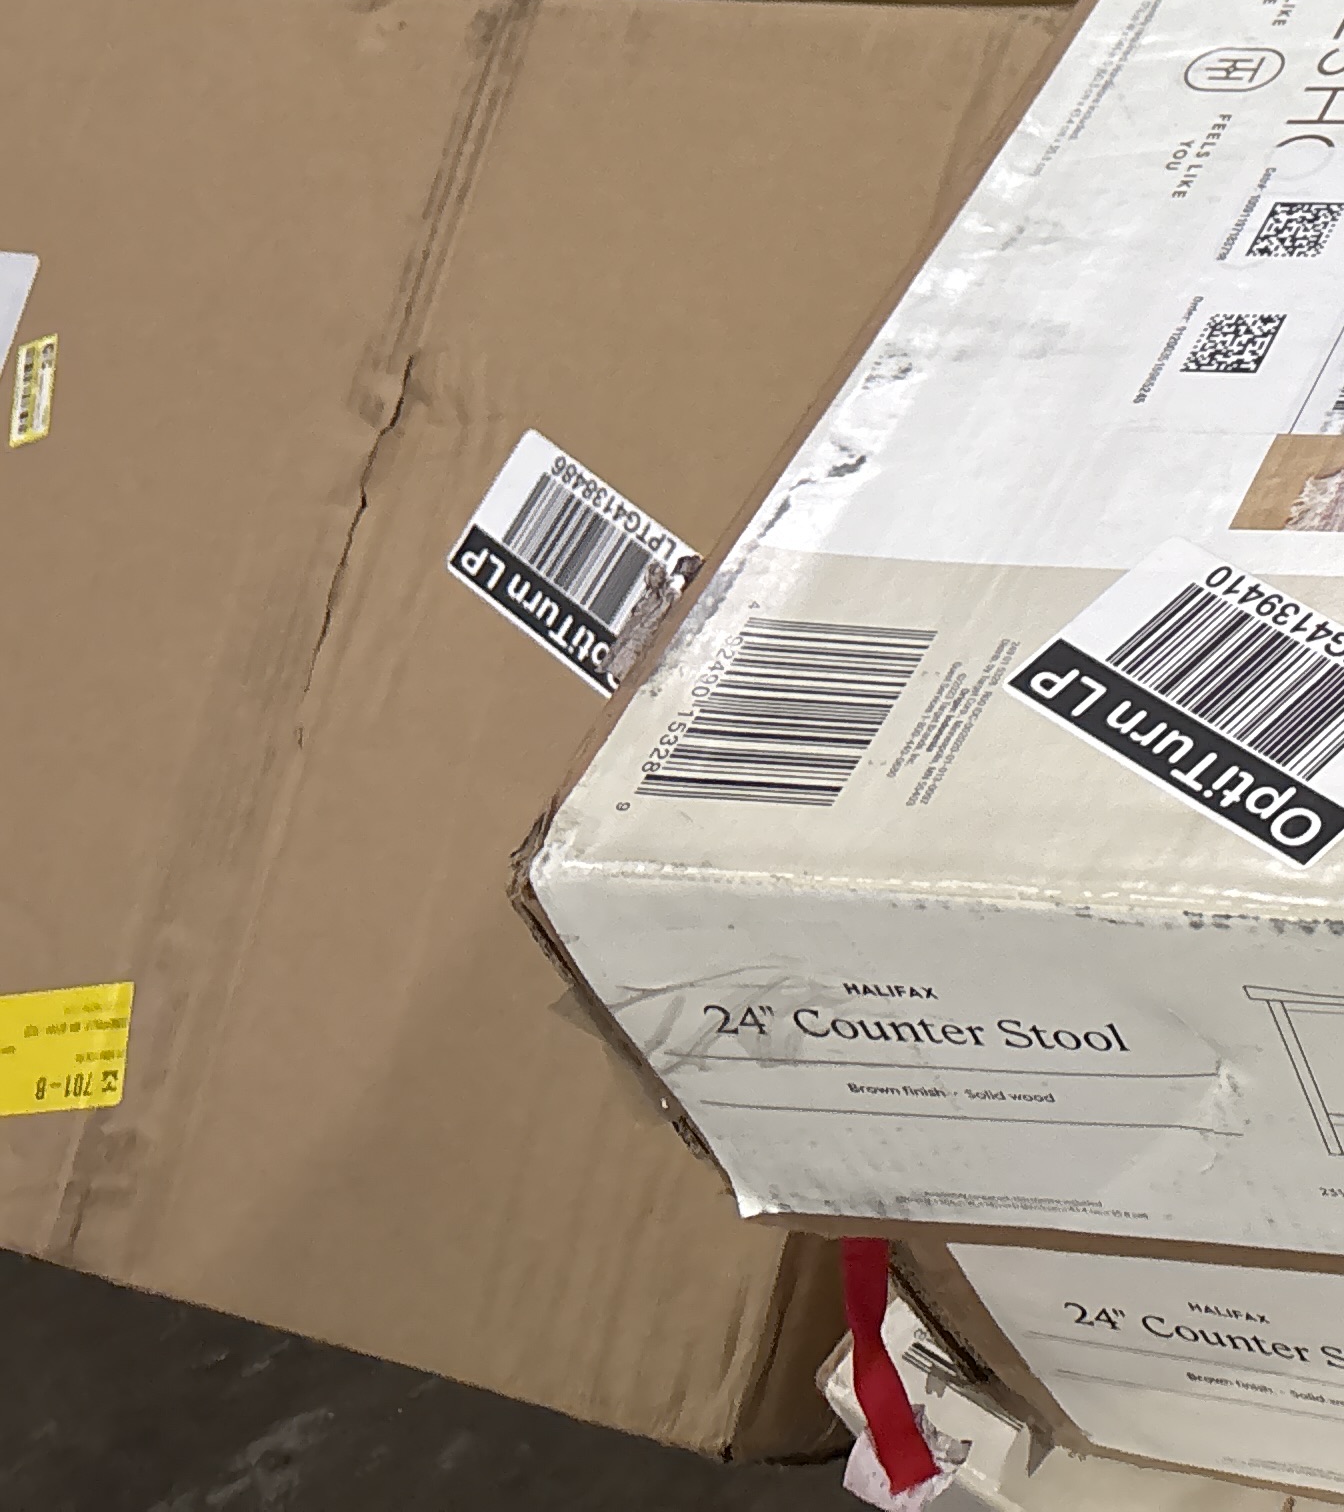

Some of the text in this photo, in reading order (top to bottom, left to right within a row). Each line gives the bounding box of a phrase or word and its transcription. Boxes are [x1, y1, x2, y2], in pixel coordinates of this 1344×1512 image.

[1165, 140, 1195, 173] YOU
[1169, 113, 1233, 198] FEELS LIKE
[543, 452, 683, 561] LPTG4138486
[455, 538, 510, 591] LP
[688, 634, 744, 697] 92490
[1022, 656, 1112, 718] LP
[638, 709, 696, 773] 15328
[1092, 688, 1337, 856] OptiTurn
[843, 981, 939, 1001] HALIFAX
[793, 1009, 987, 1051] Counter
[998, 1019, 1131, 1055] Stool
[847, 1082, 1056, 1106] Brown finish Solid wood
[1141, 1314, 1310, 1365] Counter
[1188, 1300, 1271, 1326] HALIFAX
